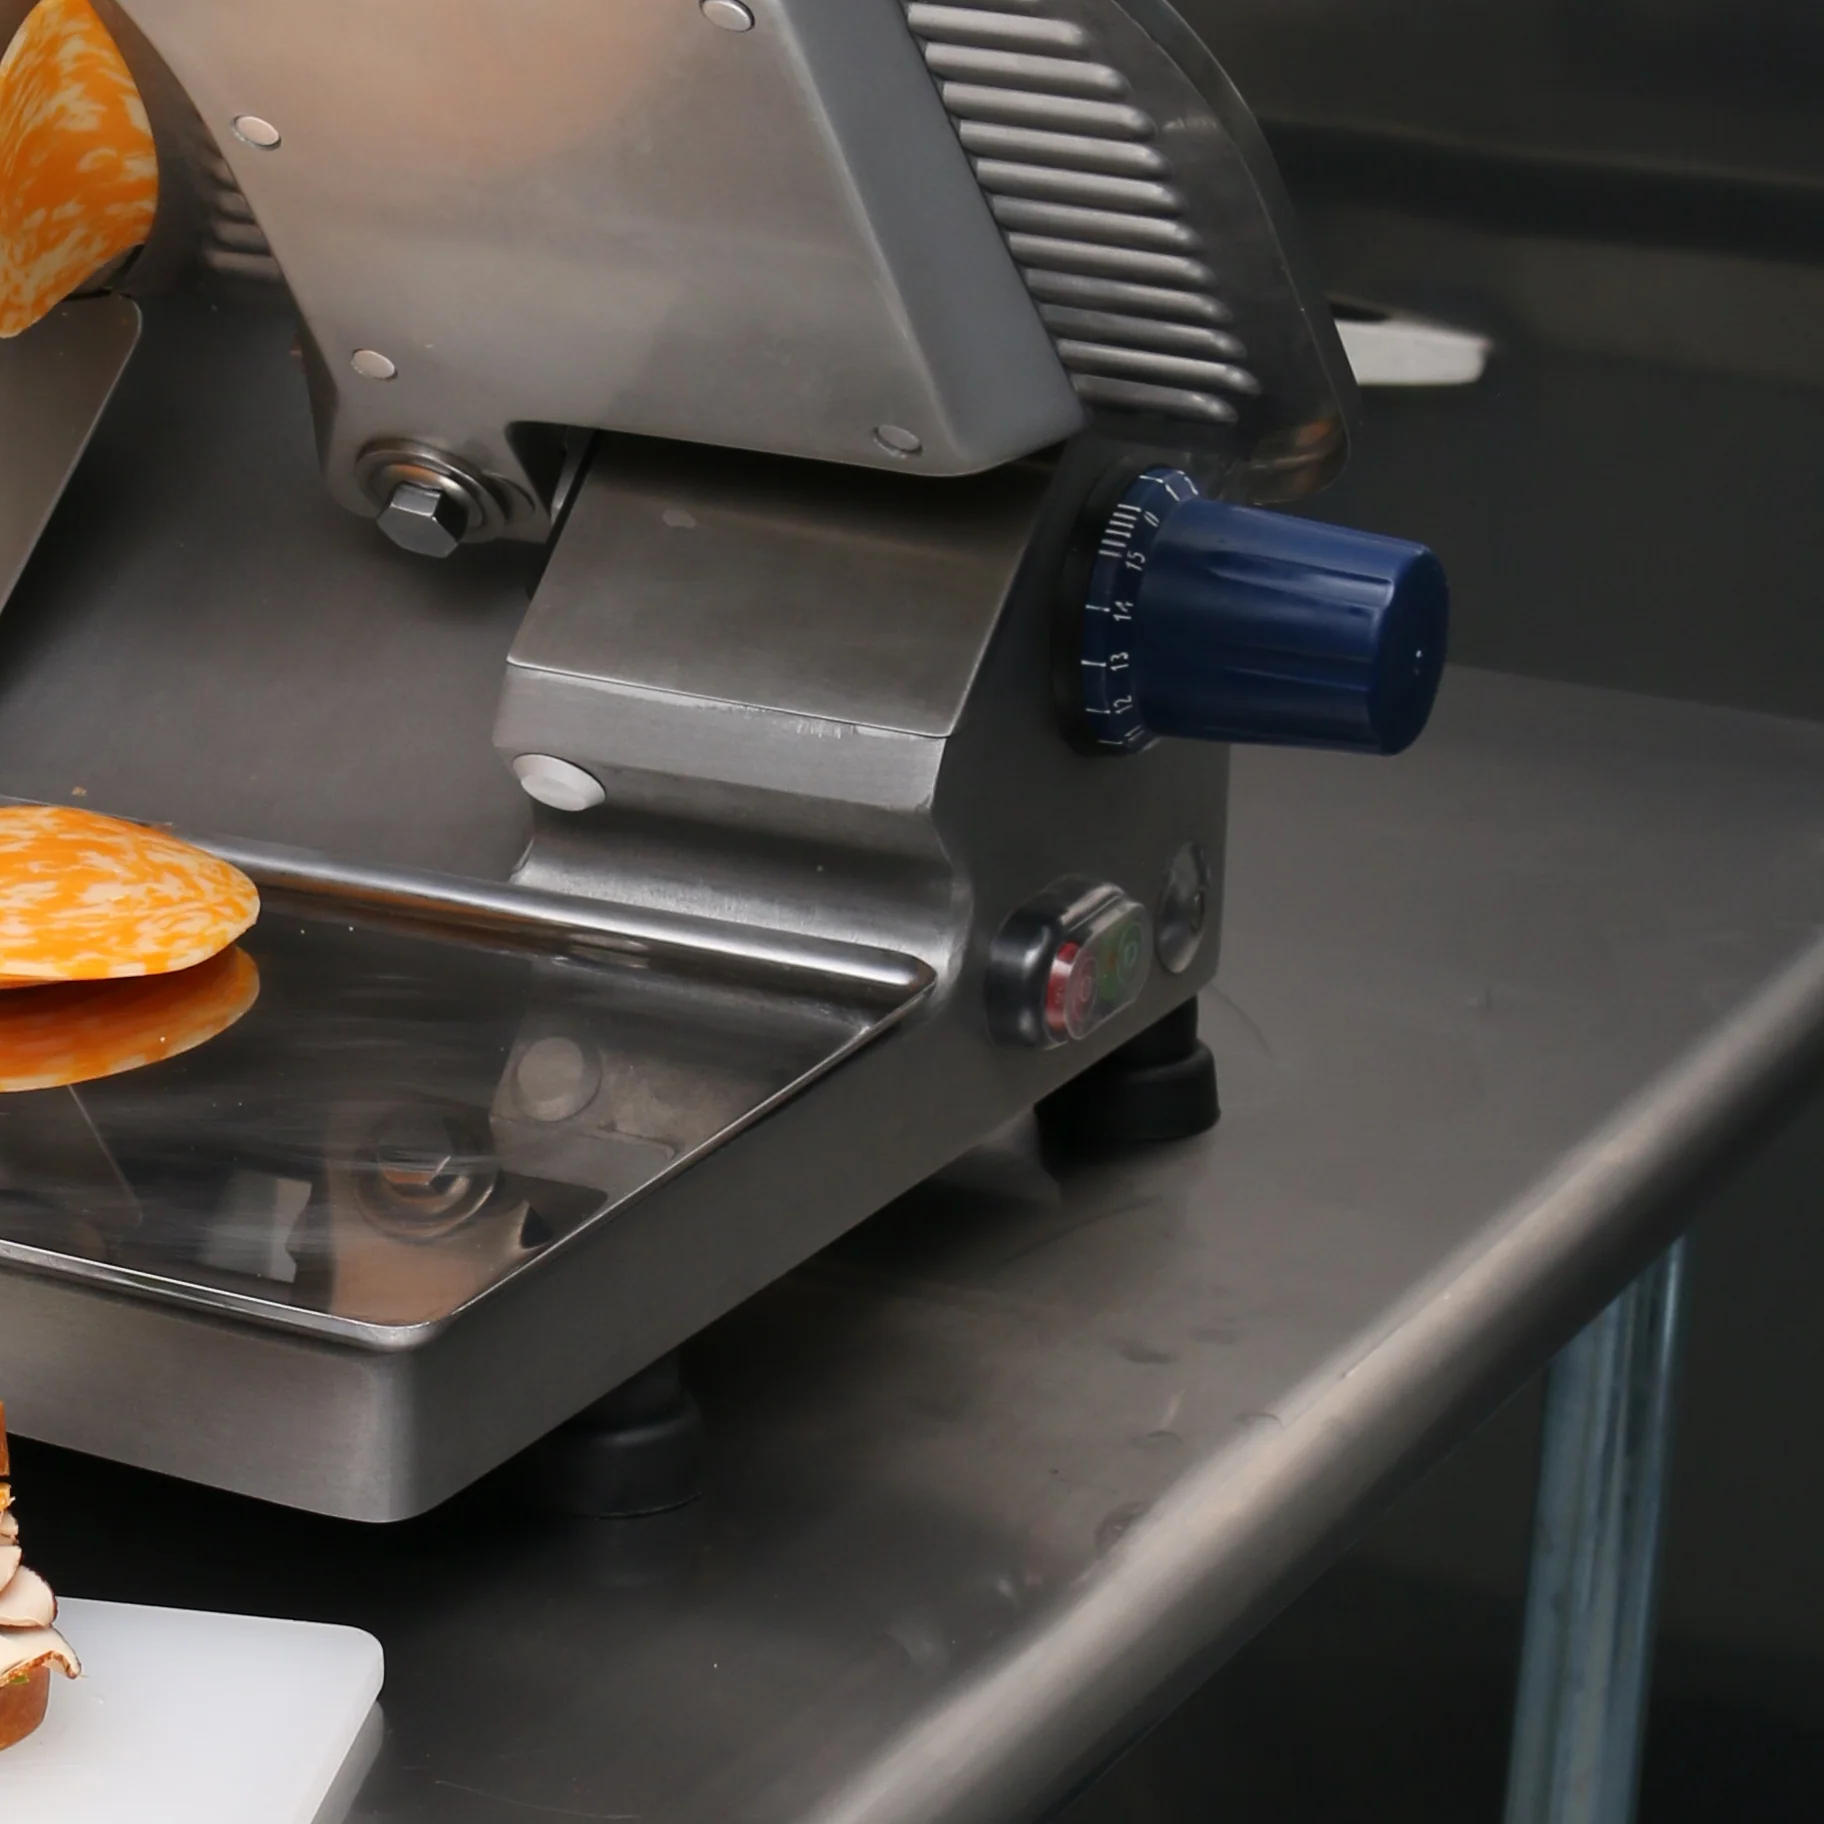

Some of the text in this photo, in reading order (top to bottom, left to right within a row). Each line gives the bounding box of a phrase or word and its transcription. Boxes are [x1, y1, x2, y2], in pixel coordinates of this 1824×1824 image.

[1125, 550, 1146, 571] 15
[1109, 651, 1129, 672] 13
[1113, 694, 1133, 715] 12
